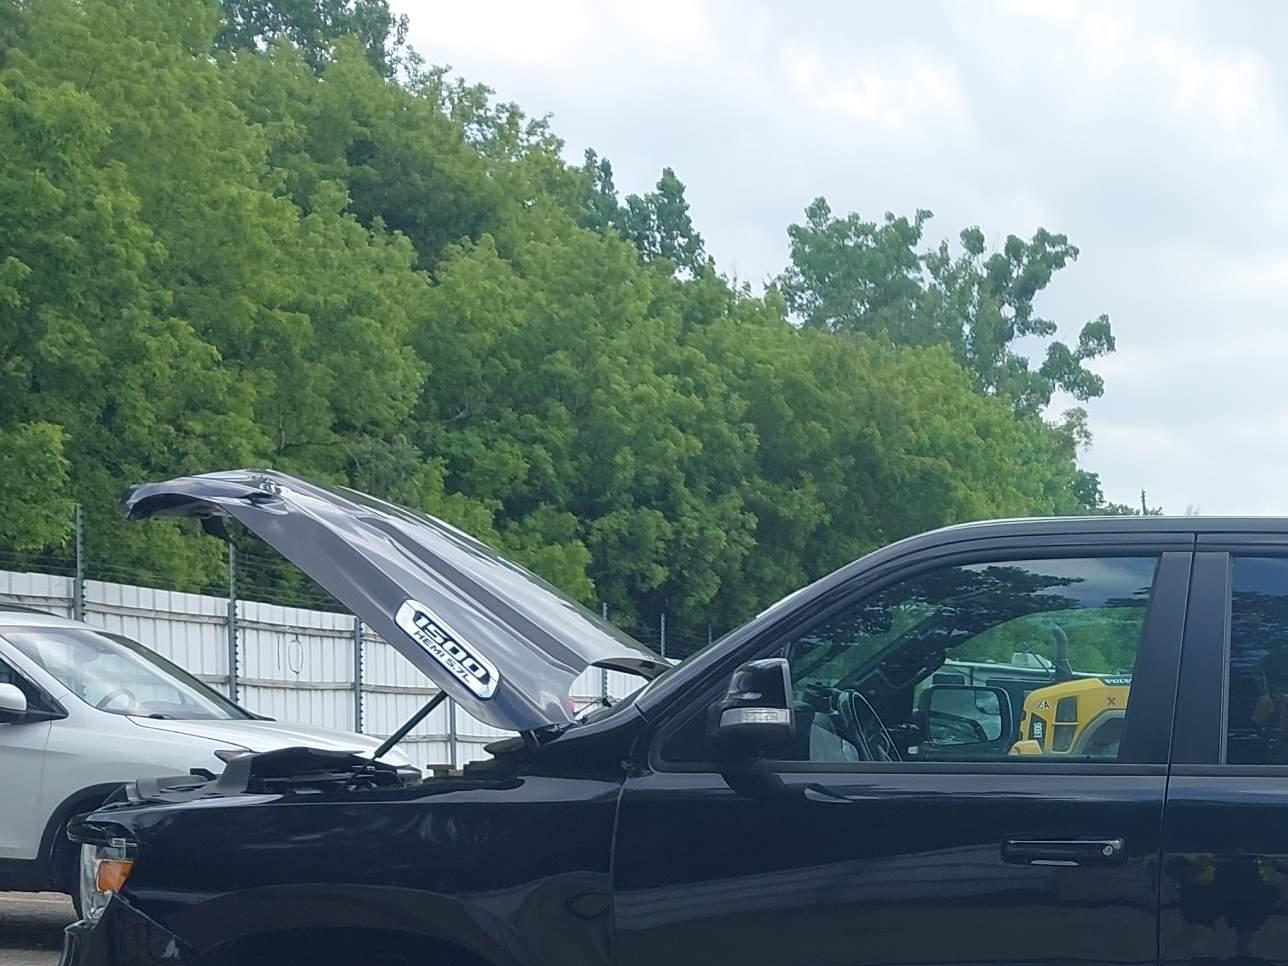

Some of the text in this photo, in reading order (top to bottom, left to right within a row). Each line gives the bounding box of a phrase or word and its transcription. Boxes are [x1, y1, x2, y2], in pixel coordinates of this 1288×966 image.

[414, 631, 471, 683] HEMI 5.7L
[415, 615, 487, 679] 1500
